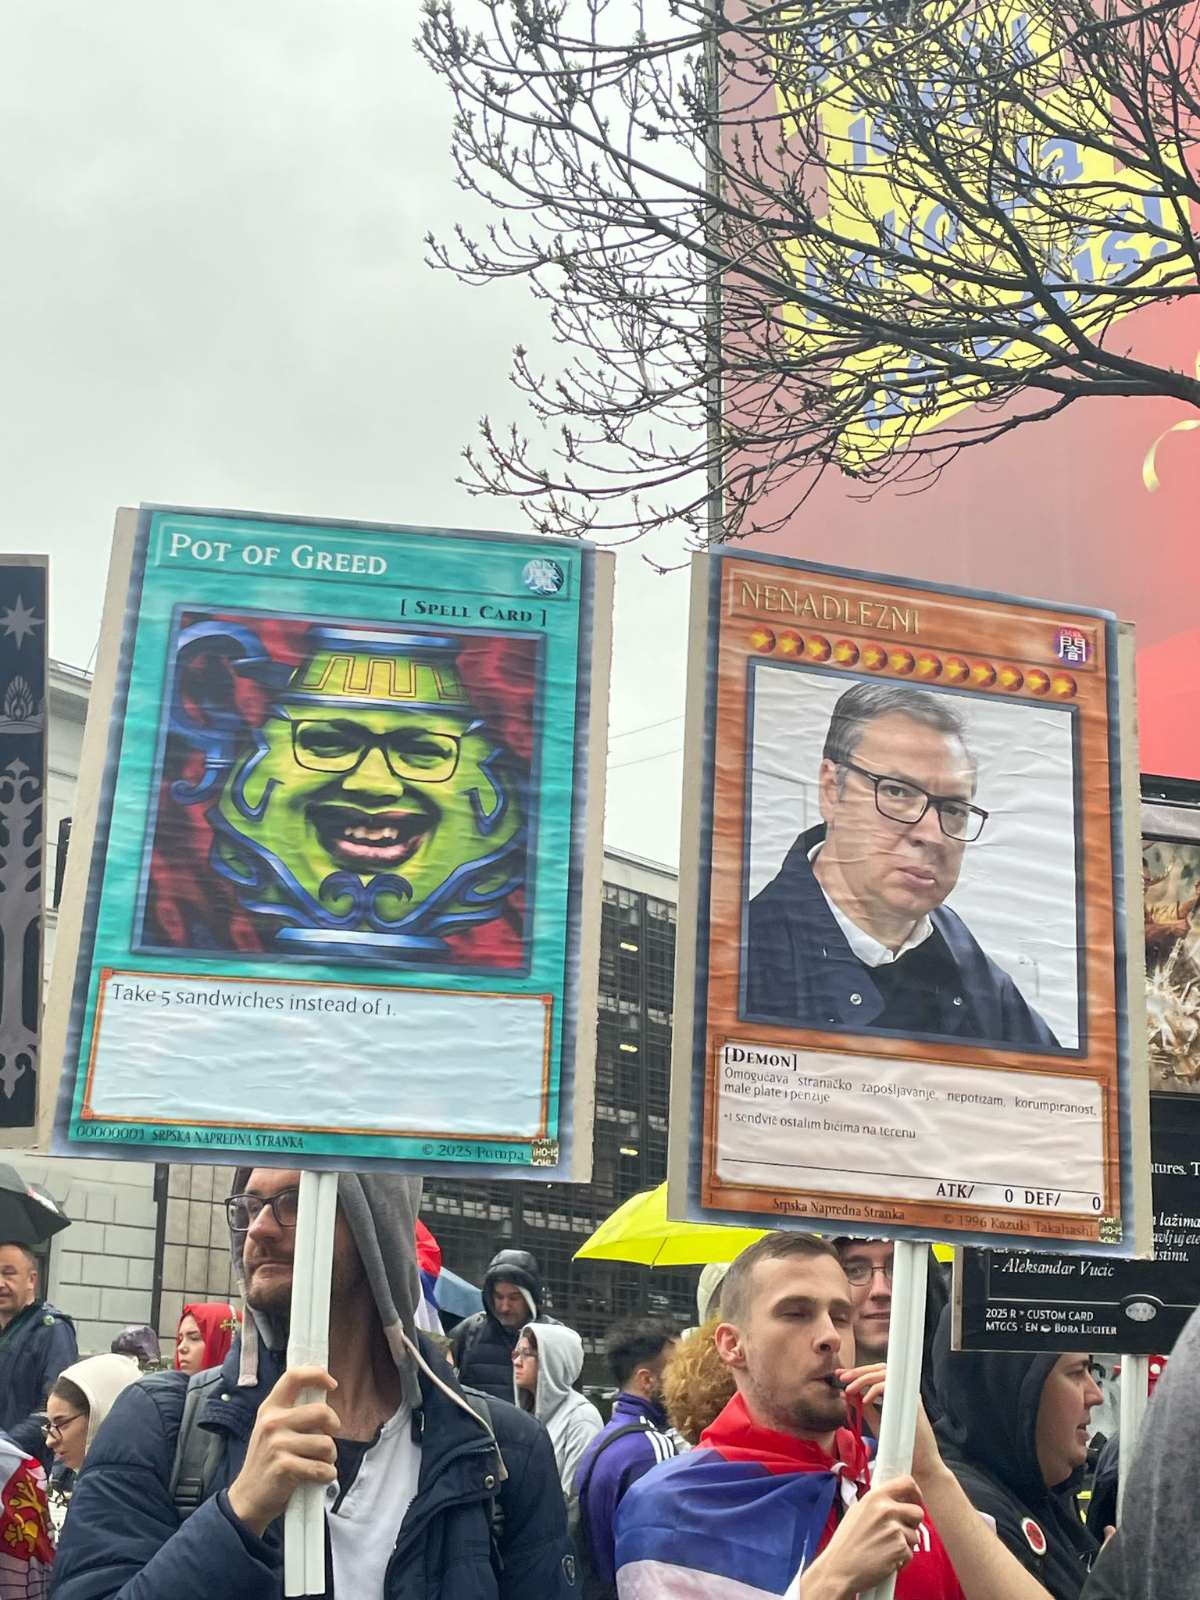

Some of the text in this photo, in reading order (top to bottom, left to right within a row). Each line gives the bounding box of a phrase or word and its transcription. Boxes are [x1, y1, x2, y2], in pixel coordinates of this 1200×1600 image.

[112, 983, 156, 1002] Take
[161, 991, 171, 1007] 5
[175, 989, 284, 1010] sandwiches
[290, 994, 358, 1013] instead
[362, 997, 382, 1015] of
[724, 1082, 752, 1095] male
[753, 1084, 782, 1098] plate
[780, 1117, 821, 1130] ostalim
[862, 1126, 877, 1136] na
[879, 1126, 916, 1139] terenu
[152, 1129, 192, 1144] SRPSKA
[192, 1131, 253, 1147] NAPREDNA
[254, 1134, 304, 1149] STRANKA
[1151, 1163, 1187, 1175] tures.
[936, 1183, 1101, 1211] ATK/ 0 DEF/ 0
[1001, 1258, 1076, 1276] Aleksandar
[986, 1308, 1008, 1318] 2025
[1027, 1310, 1066, 1320] CUSTOM
[1068, 1311, 1094, 1321] CARD
[1025, 1323, 1038, 1332] EN
